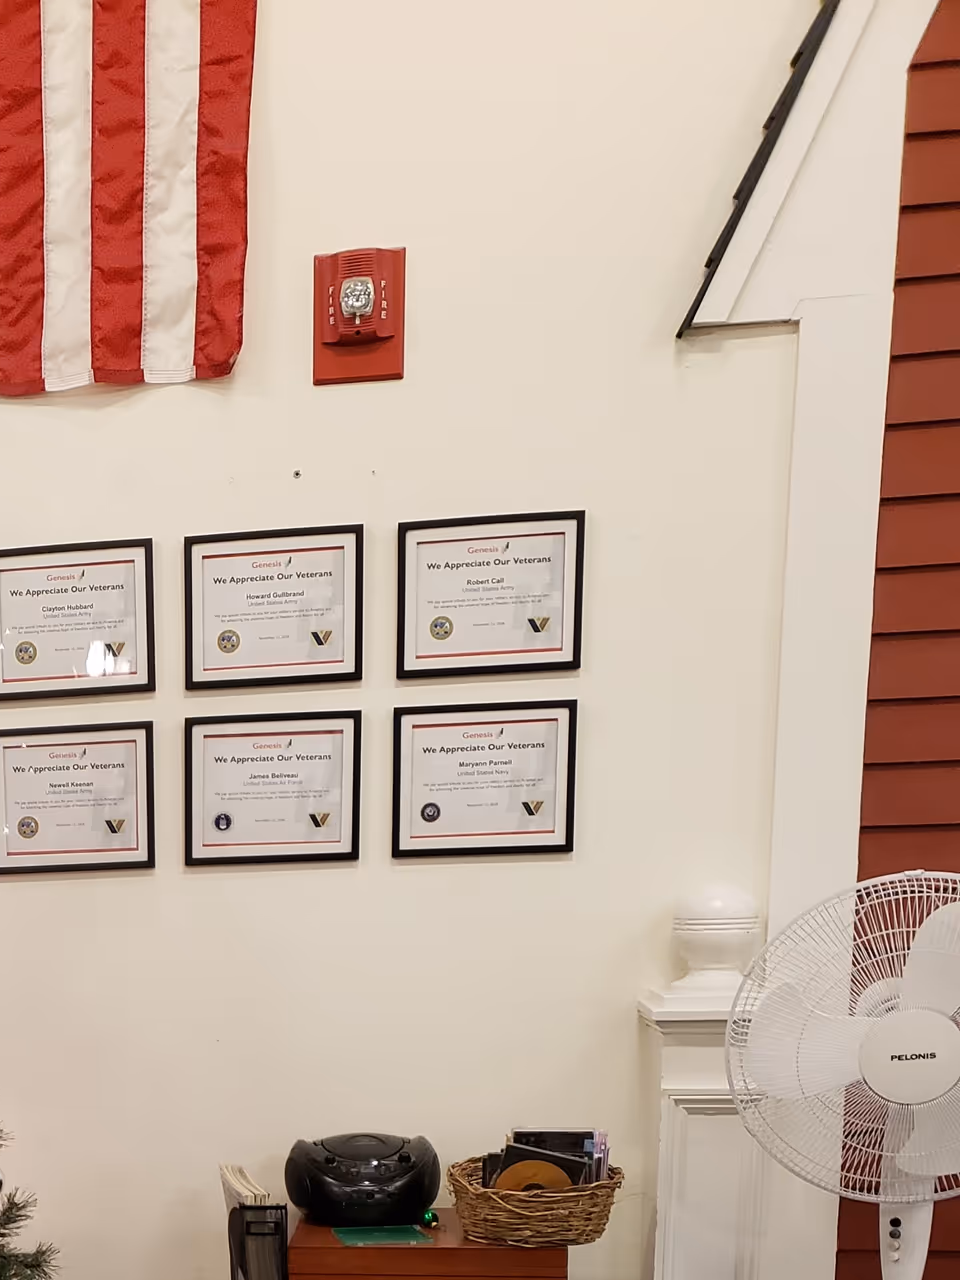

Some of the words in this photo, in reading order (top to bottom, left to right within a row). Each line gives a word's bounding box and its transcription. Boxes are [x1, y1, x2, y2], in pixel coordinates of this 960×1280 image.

[444, 560, 491, 570] Appreciate
[229, 575, 274, 585] Appreciate
[26, 587, 68, 597] Appreciate
[462, 731, 493, 739] Genesis
[439, 745, 485, 754] Appreciate
[230, 755, 274, 764] Appreciate
[28, 764, 70, 774] Appreciate
[891, 1052, 936, 1061] PELONIS
